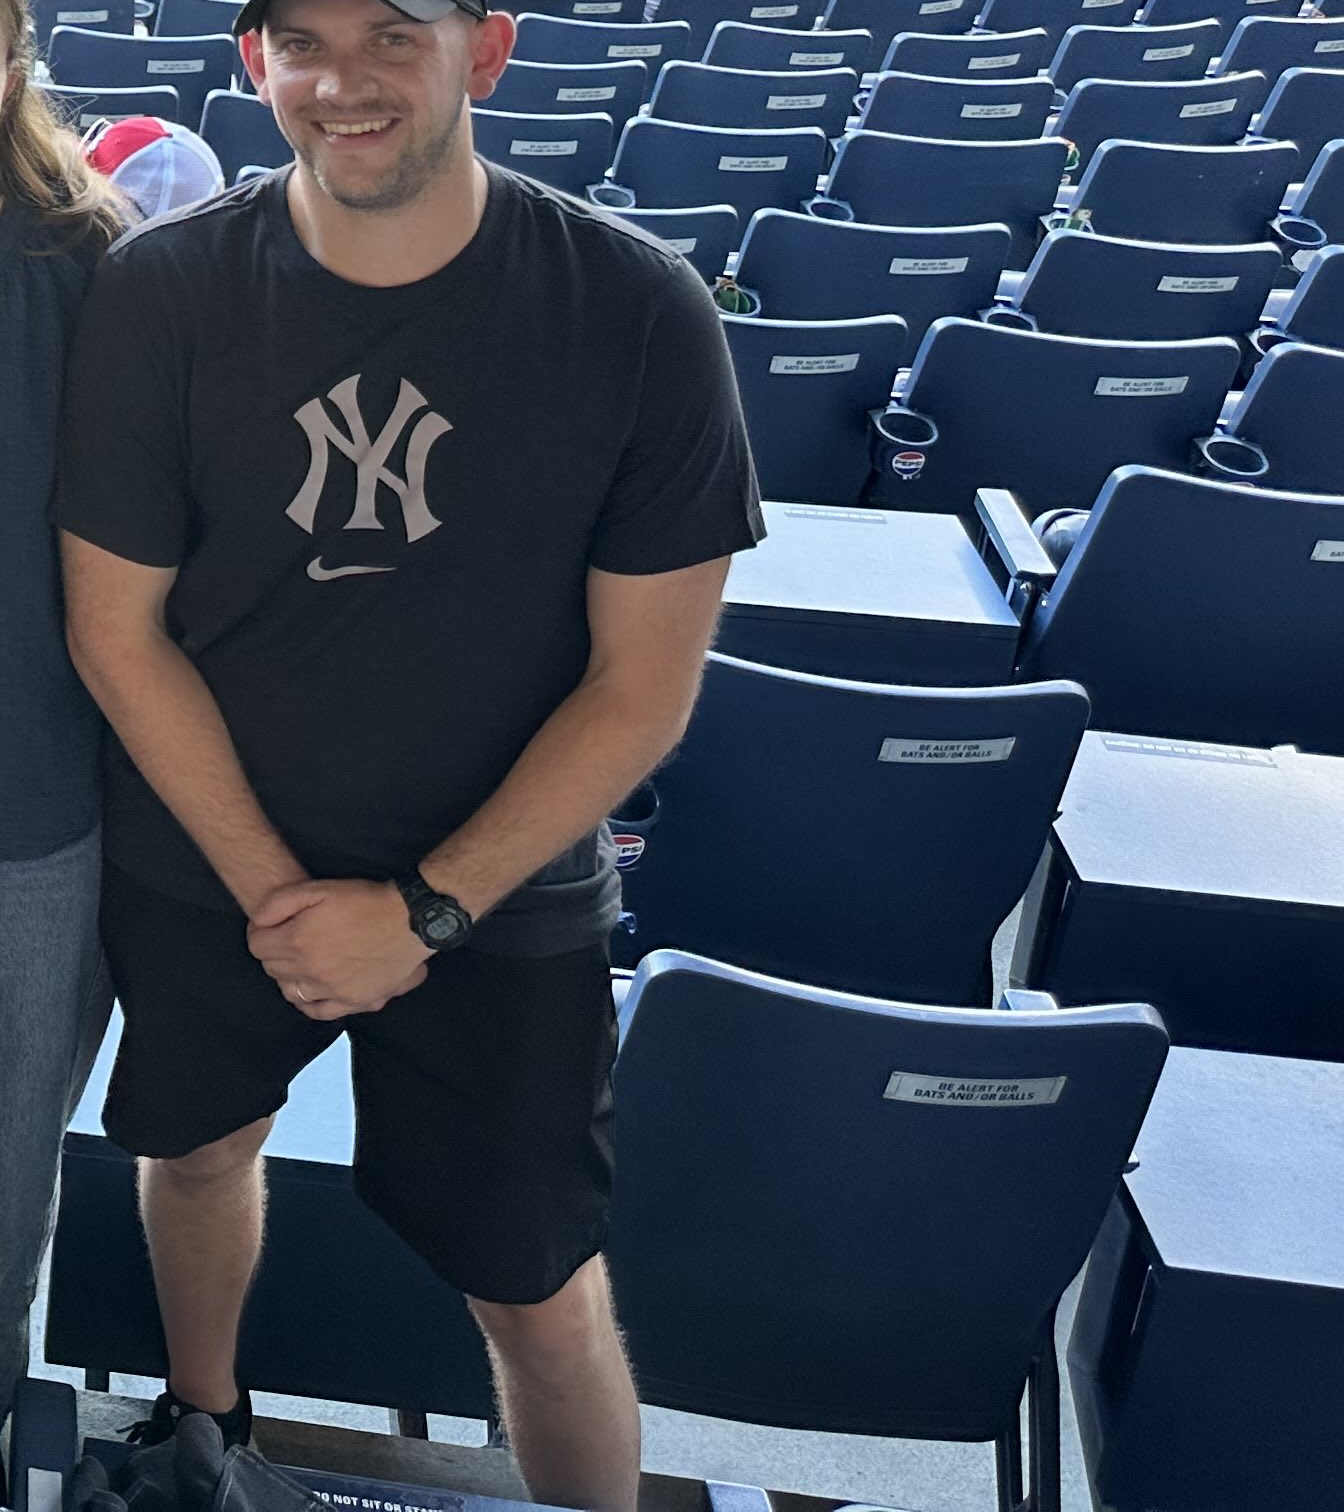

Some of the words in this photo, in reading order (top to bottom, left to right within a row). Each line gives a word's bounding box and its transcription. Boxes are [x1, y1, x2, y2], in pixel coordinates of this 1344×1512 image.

[284, 373, 455, 544] NY
[964, 750, 992, 758] BALLS
[939, 1082, 955, 1090] BE
[958, 1083, 994, 1092] ALERT
[995, 1084, 1019, 1092] FOR
[914, 1088, 946, 1099] BATS
[948, 1091, 995, 1100] AND/OR
[998, 1092, 1034, 1101] BALLS
[333, 1494, 358, 1506] NOT
[361, 1499, 381, 1510] SIT
[383, 1502, 401, 1512] OR
